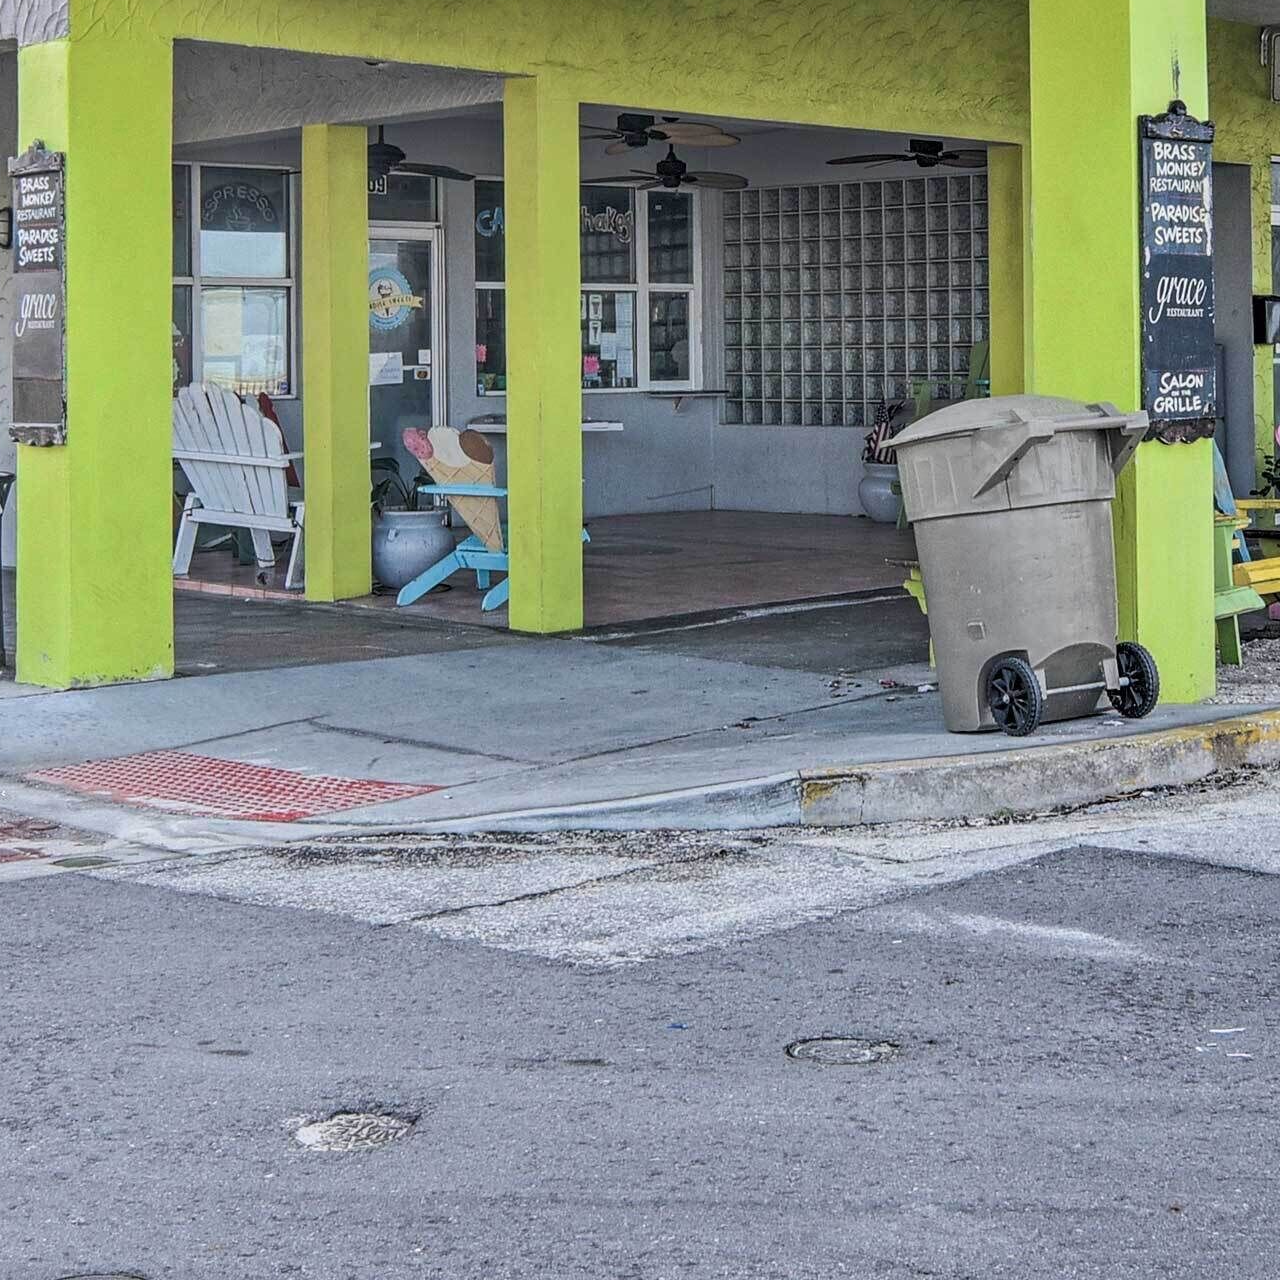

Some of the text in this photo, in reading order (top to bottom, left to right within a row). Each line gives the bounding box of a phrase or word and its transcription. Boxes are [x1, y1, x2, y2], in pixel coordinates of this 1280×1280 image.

[1152, 142, 1196, 161] BRASS
[1156, 161, 1206, 177] MONKEY
[20, 176, 50, 195] BRASS
[22, 190, 57, 208] MONKEY
[203, 185, 276, 223] ESPRESSO
[16, 207, 57, 223] RESTAURANT
[1150, 202, 1207, 223] PARADISE
[18, 228, 60, 248] PARADISE
[1154, 225, 1204, 246] SWEETS
[18, 246, 56, 266] SWEETS
[1148, 276, 1208, 325] grace
[15, 293, 59, 338] grace
[1166, 308, 1205, 318] RESTAURANT
[1158, 372, 1205, 395] SALON
[1153, 395, 1203, 414] GRILLE
